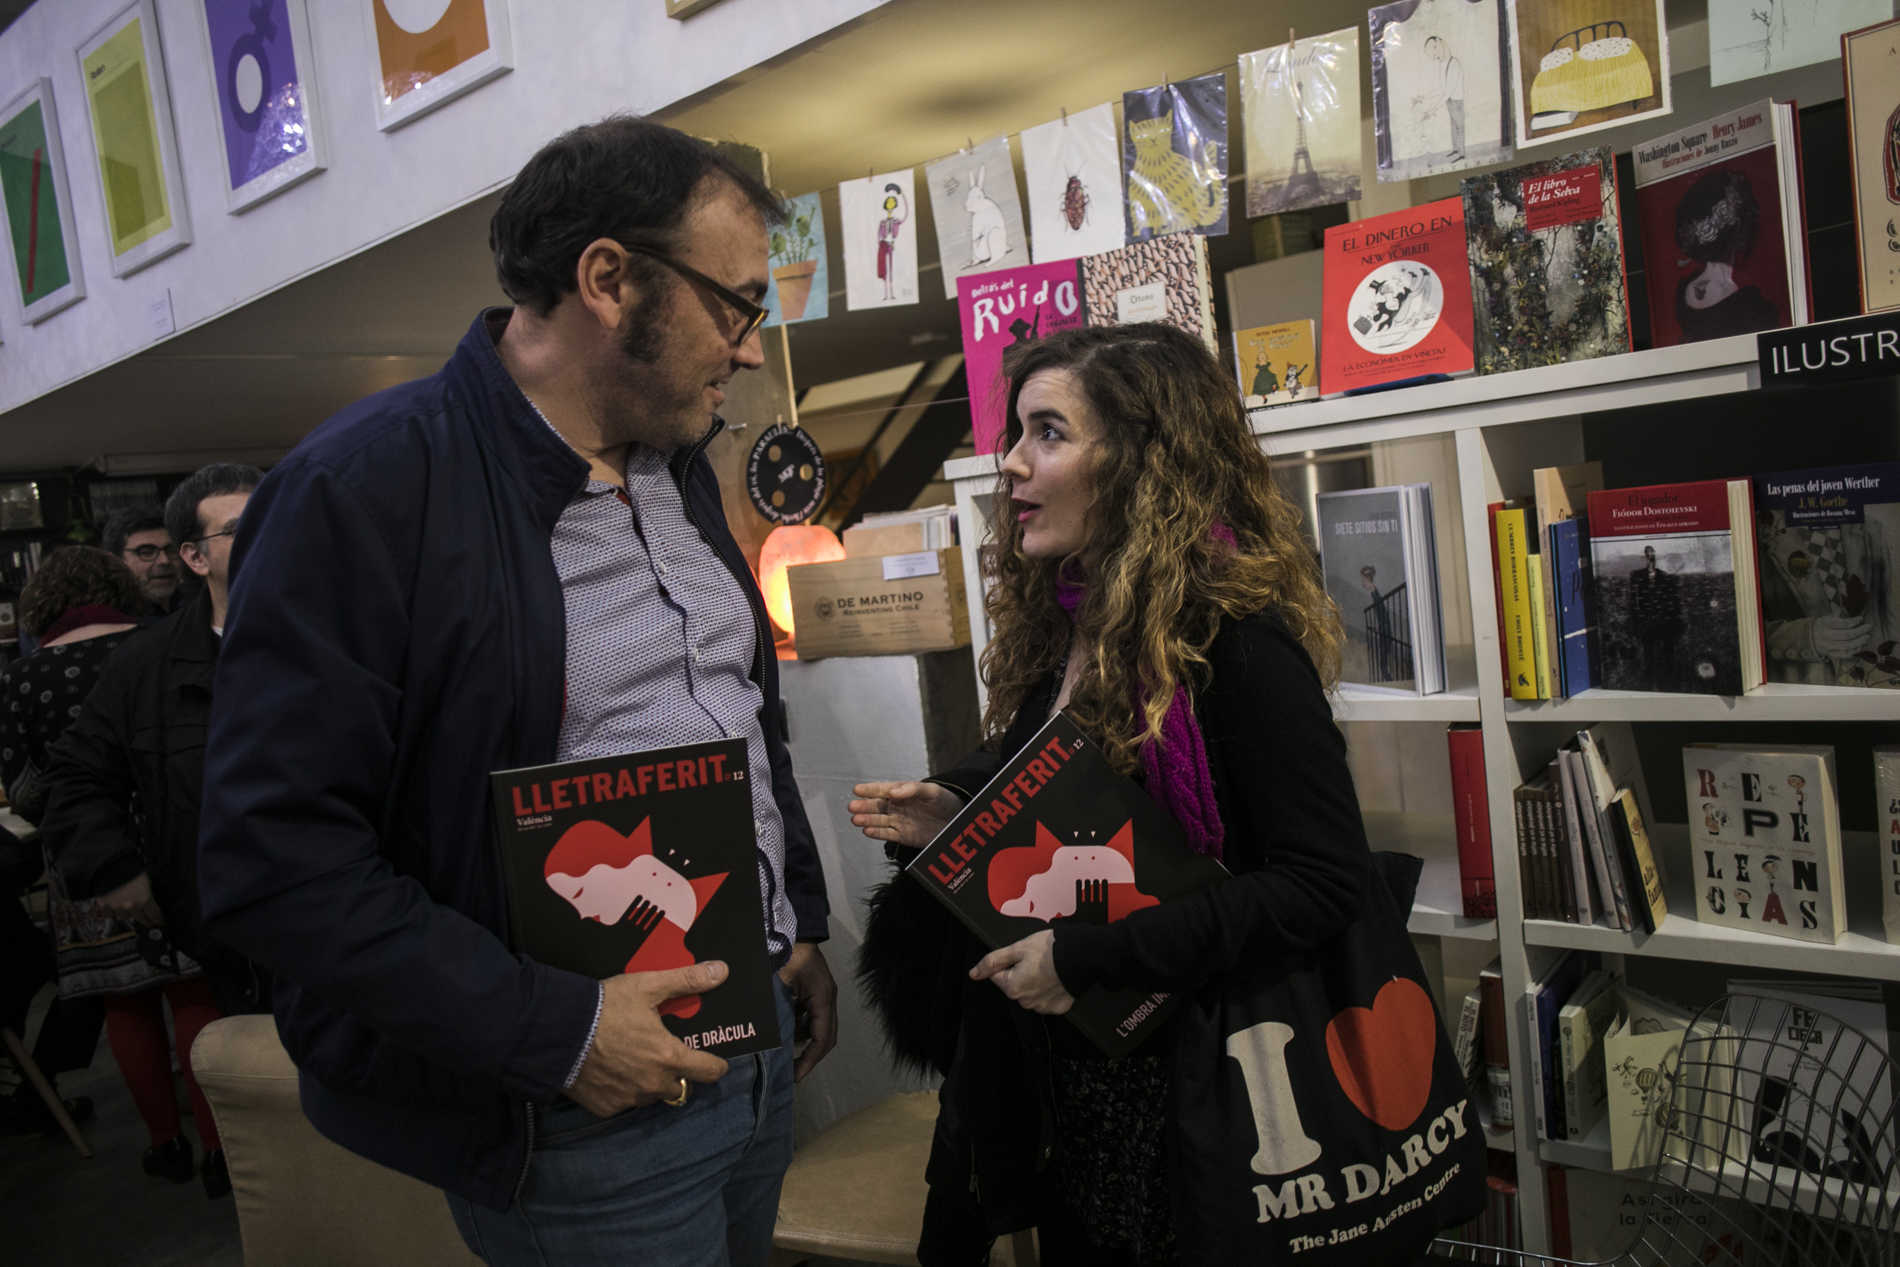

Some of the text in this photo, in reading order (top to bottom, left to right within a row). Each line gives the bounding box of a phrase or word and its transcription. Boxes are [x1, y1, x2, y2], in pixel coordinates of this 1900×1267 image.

[1638, 113, 1763, 165] Washington Square Henry James
[1528, 179, 1568, 194] El libro
[1528, 186, 1581, 205] de la Selva
[1343, 238, 1358, 252] EL
[1365, 222, 1425, 247] DINERO
[1430, 216, 1453, 232] EN
[1361, 242, 1430, 265] NEW YORKER
[1767, 475, 1880, 497] Las penas del joven Werther
[1335, 520, 1354, 536] SIETE
[1377, 519, 1390, 534] SIN
[837, 591, 924, 609] DE MARTINO
[511, 753, 744, 817] LLETRAFERIT 12
[928, 736, 1085, 885] LLETRAFERIT 12
[683, 1021, 757, 1050] DE DRÀCULA
[1225, 1021, 1322, 1176] I
[1252, 1173, 1336, 1224] MR
[1340, 1098, 1469, 1204] DARCY
[1289, 1234, 1326, 1255] The
[1328, 1222, 1368, 1246] Jane
